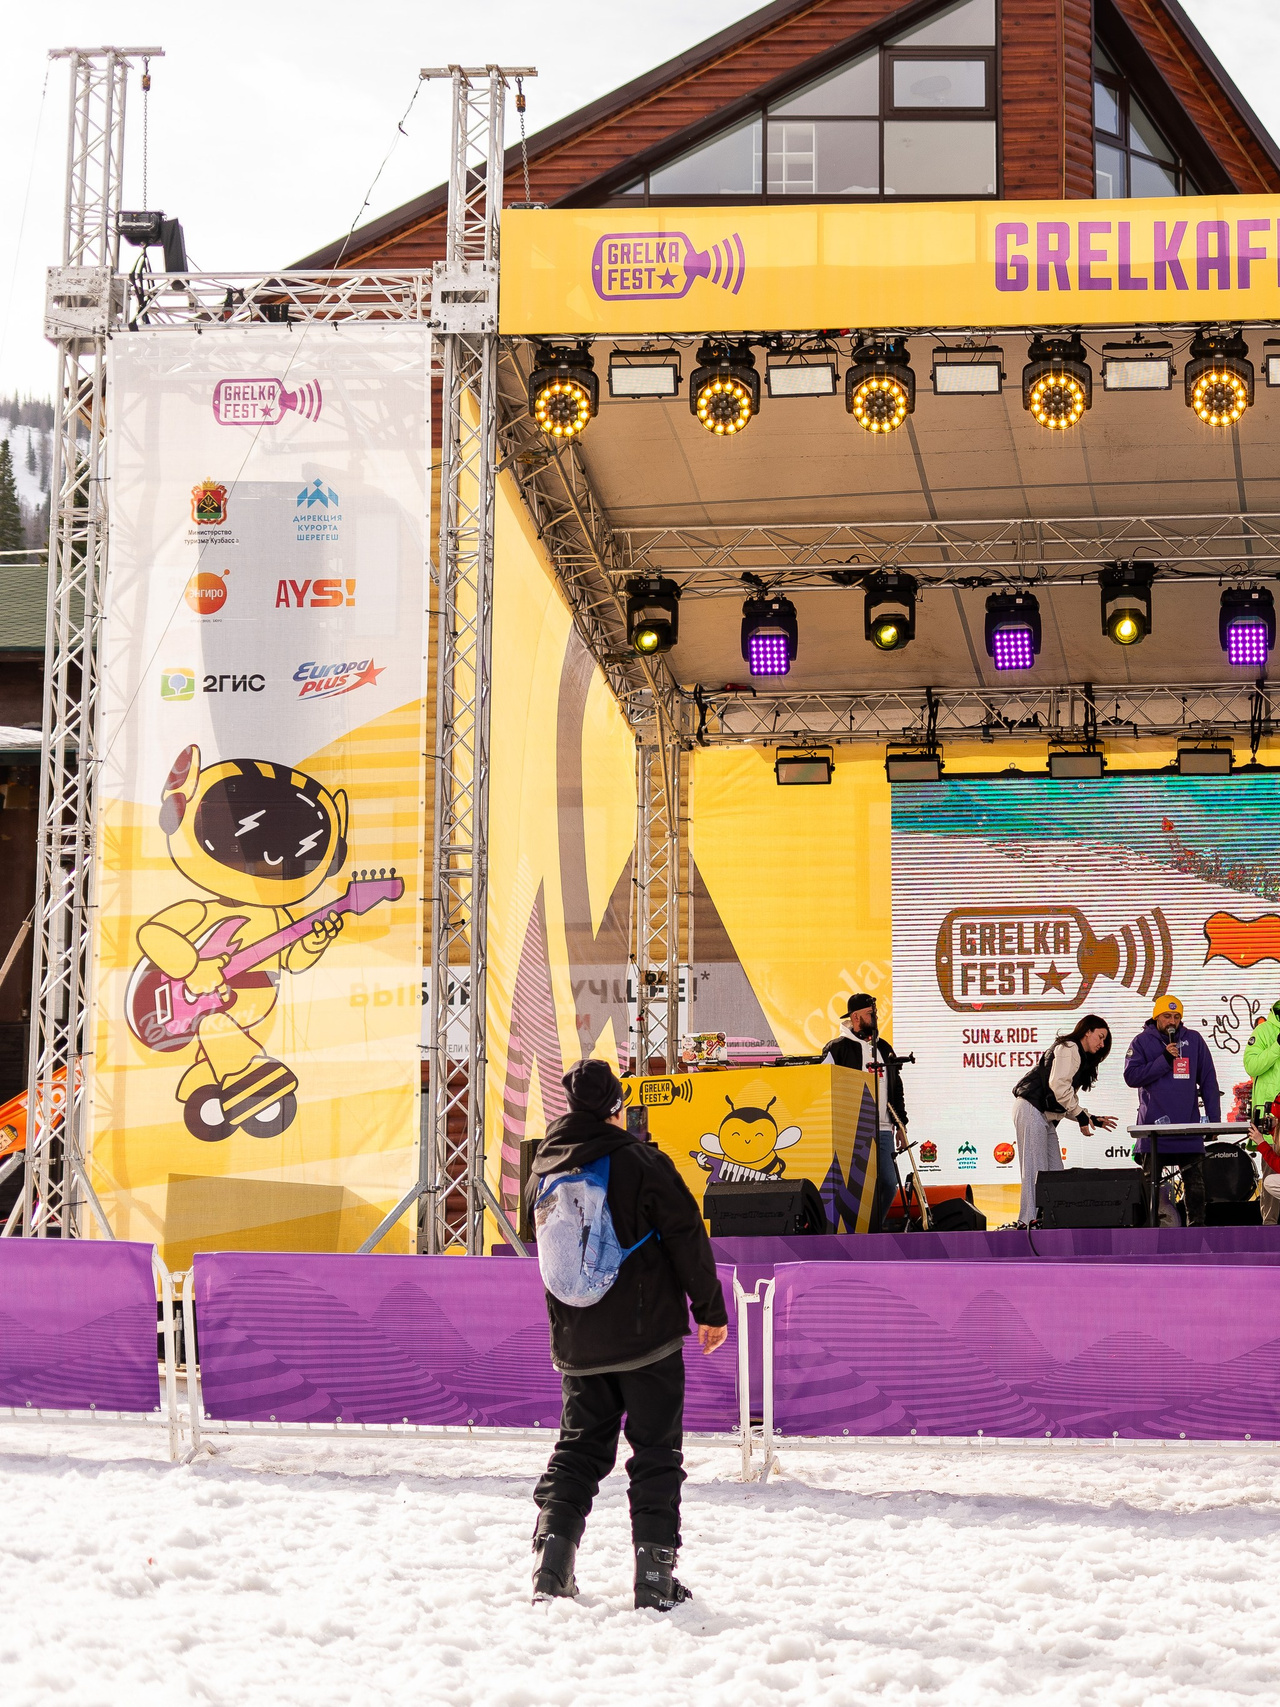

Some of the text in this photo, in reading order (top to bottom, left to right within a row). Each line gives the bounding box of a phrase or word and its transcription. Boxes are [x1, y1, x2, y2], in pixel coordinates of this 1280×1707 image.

[607, 241, 680, 266] GRELKA
[607, 268, 656, 291] FEST
[223, 385, 276, 402] GRELKA
[223, 403, 259, 420] FEST
[292, 514, 343, 523] ДИРЕКЦИЯ
[187, 529, 233, 537] Министерство
[297, 524, 339, 532] КУРОРТА
[296, 533, 339, 541] ШЕРЕГЕШ
[189, 588, 224, 601] энгиро
[274, 578, 357, 609] AYS!
[202, 673, 266, 694] 2ГИС
[959, 920, 1071, 957] GRELKA
[960, 961, 1036, 997] FEST
[962, 1027, 1039, 1044] SUN & RIDE
[962, 1051, 1044, 1069] MUSIC FEST
[644, 1082, 671, 1094] GRELKA
[644, 1094, 662, 1104] FEST
[1104, 1146, 1136, 1158] driv
